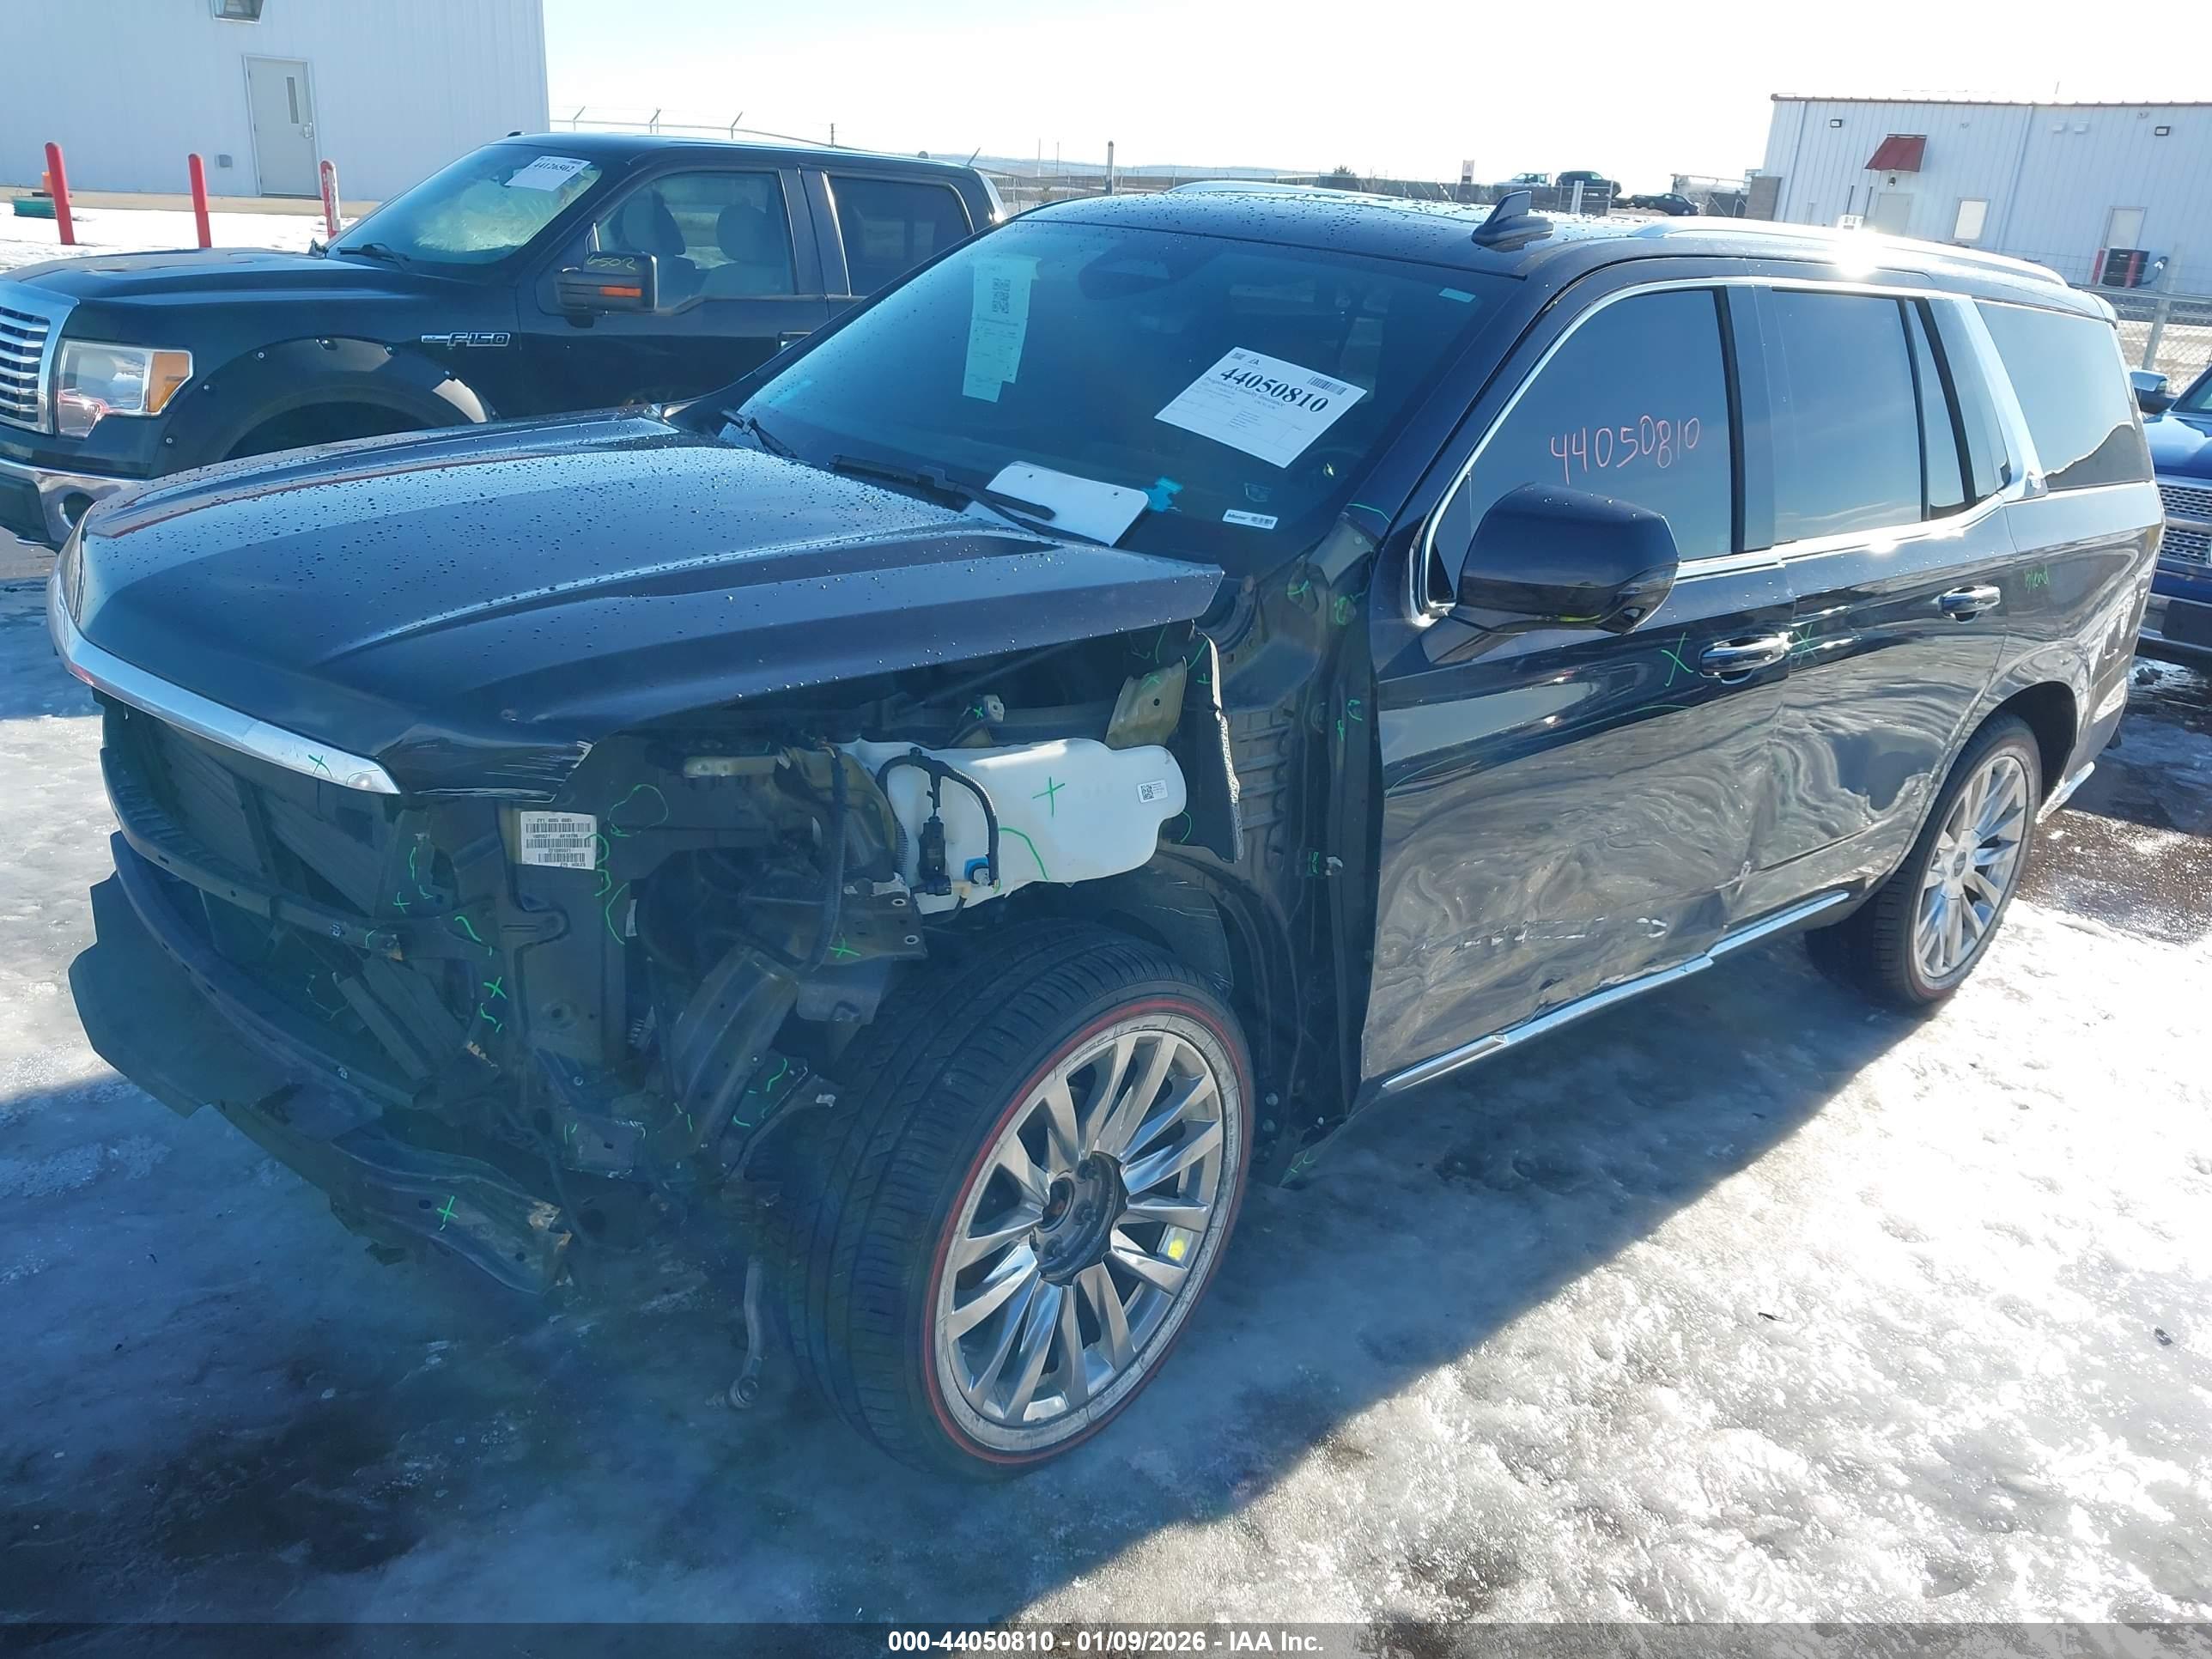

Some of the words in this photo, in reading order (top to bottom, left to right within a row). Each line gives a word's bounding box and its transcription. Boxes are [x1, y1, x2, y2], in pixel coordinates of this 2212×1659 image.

[586, 254, 636, 270] 6502
[1220, 368, 1329, 413] 44050810
[1551, 415, 1700, 485] 44050810
